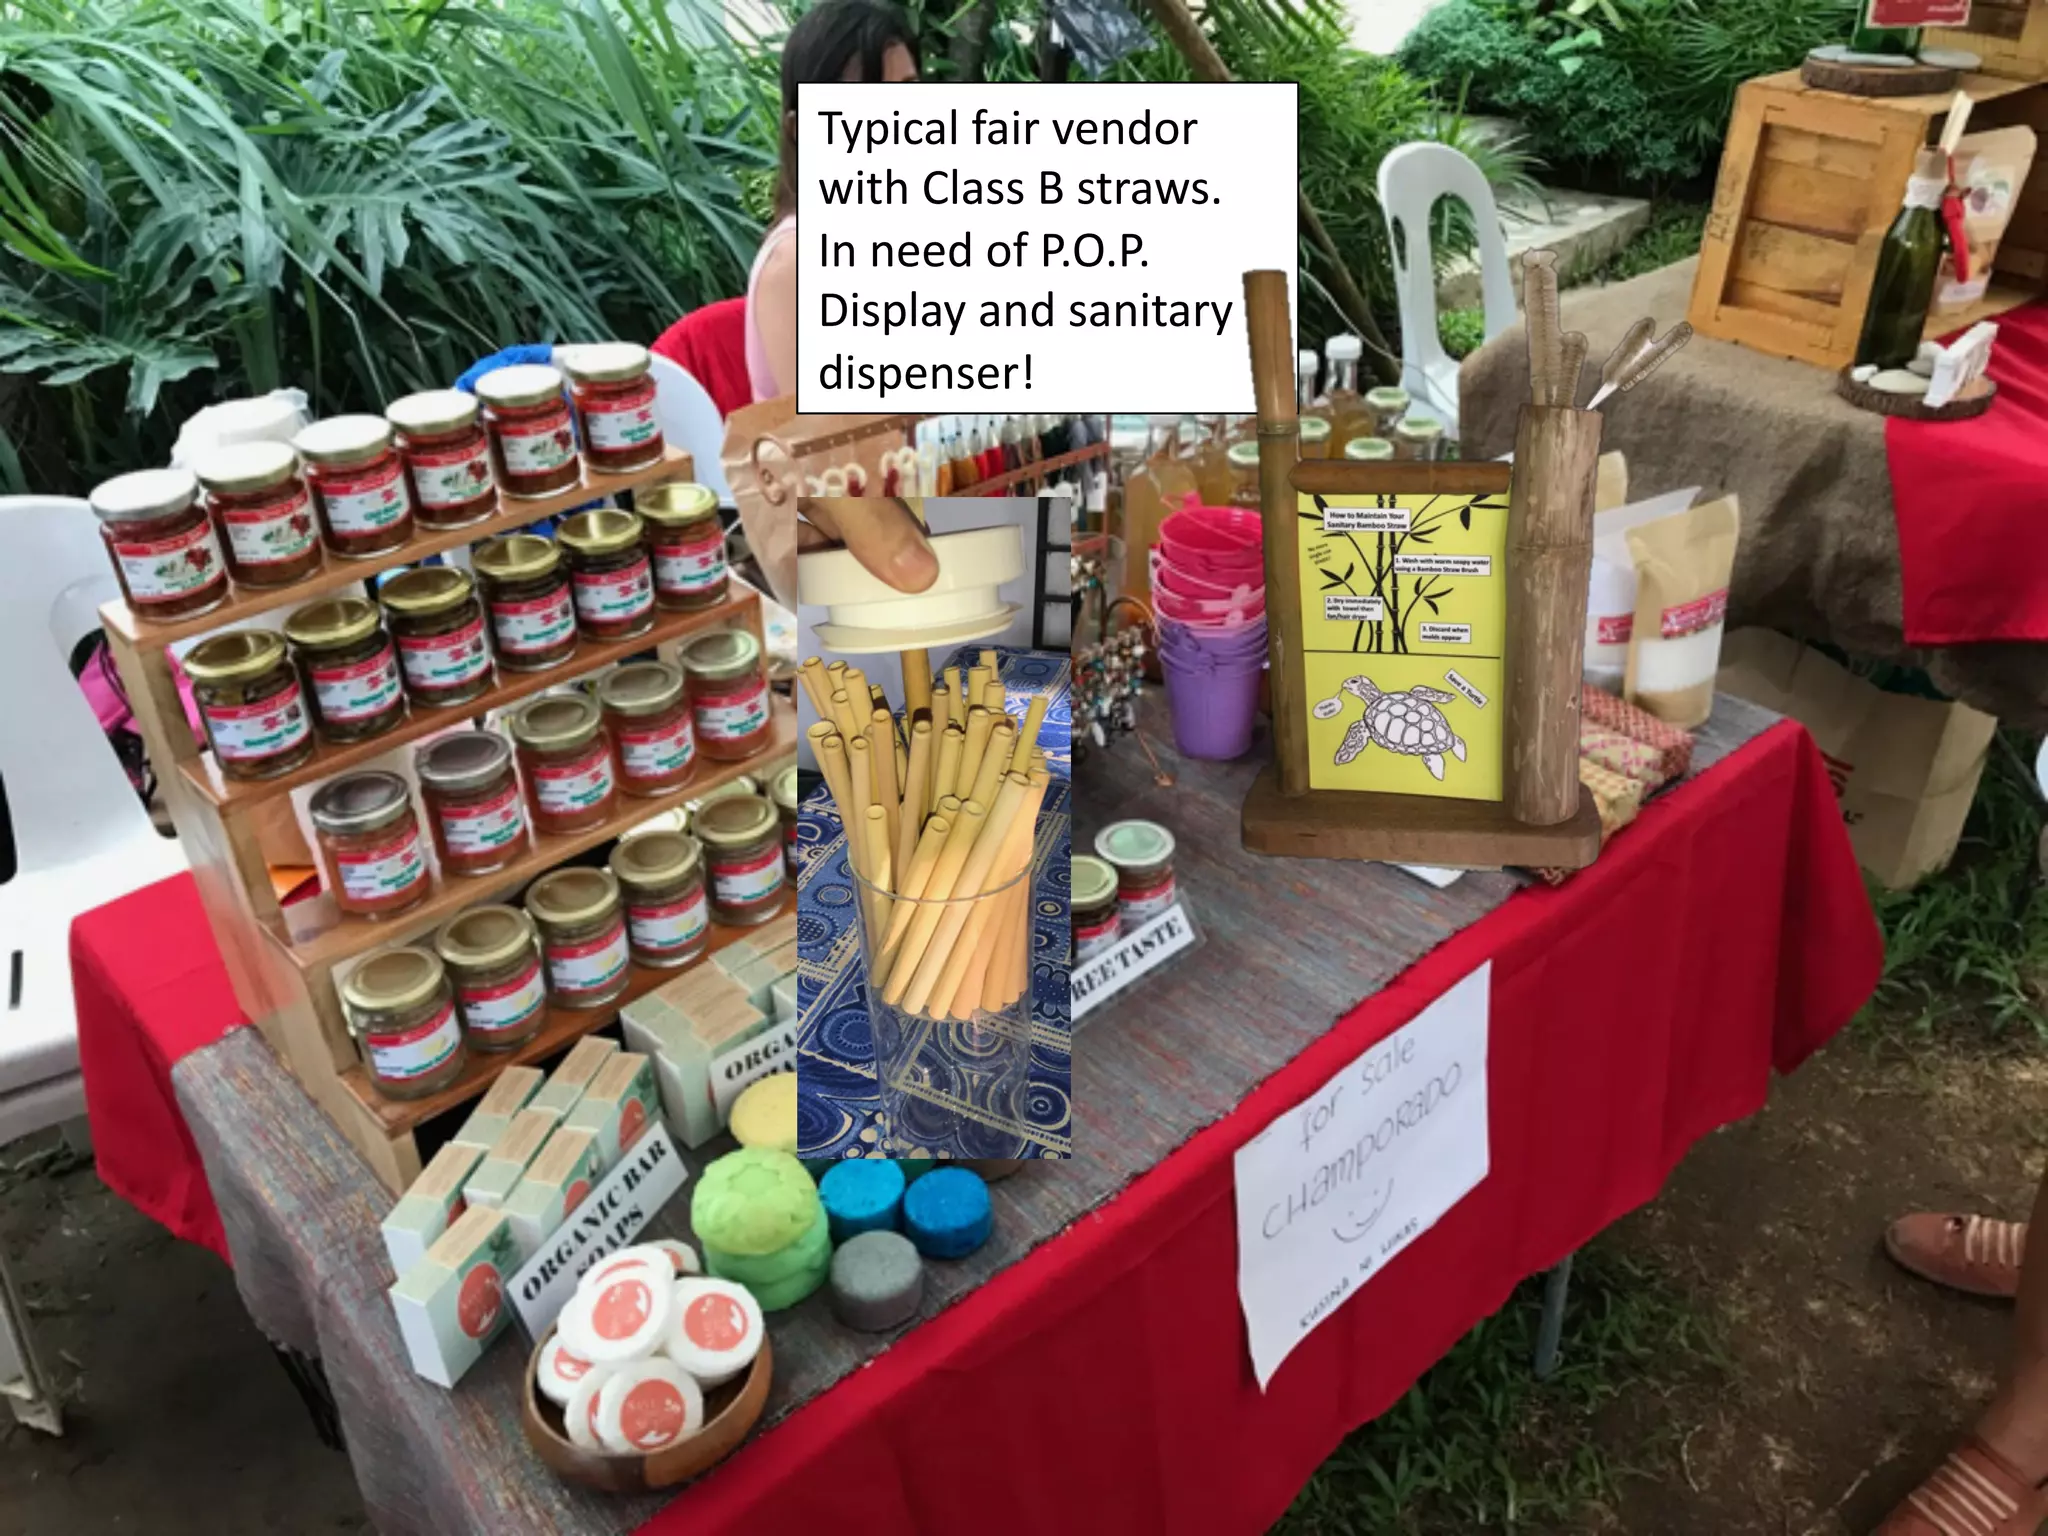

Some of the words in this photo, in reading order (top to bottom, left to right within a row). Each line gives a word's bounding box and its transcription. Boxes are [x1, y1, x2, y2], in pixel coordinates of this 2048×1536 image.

[1329, 511, 1346, 520] How
[1347, 511, 1355, 520] to
[1356, 511, 1388, 520] Maintain
[1389, 512, 1405, 521] Your
[1326, 521, 1355, 530] Sanitary
[1356, 521, 1386, 530] Bamboo
[1387, 521, 1408, 530] Straw
[1420, 557, 1434, 565] with
[1453, 559, 1471, 567] soapy
[1461, 566, 1480, 574] Brush
[1333, 597, 1344, 605] Dry
[1345, 597, 1382, 606] immediately
[1428, 625, 1451, 633] Discard
[1447, 673, 1462, 687] Save
[1465, 688, 1484, 705] Turtle
[1114, 915, 1184, 969] TASTE
[522, 1183, 624, 1301] ORGANIC
[621, 1139, 668, 1192] BAR
